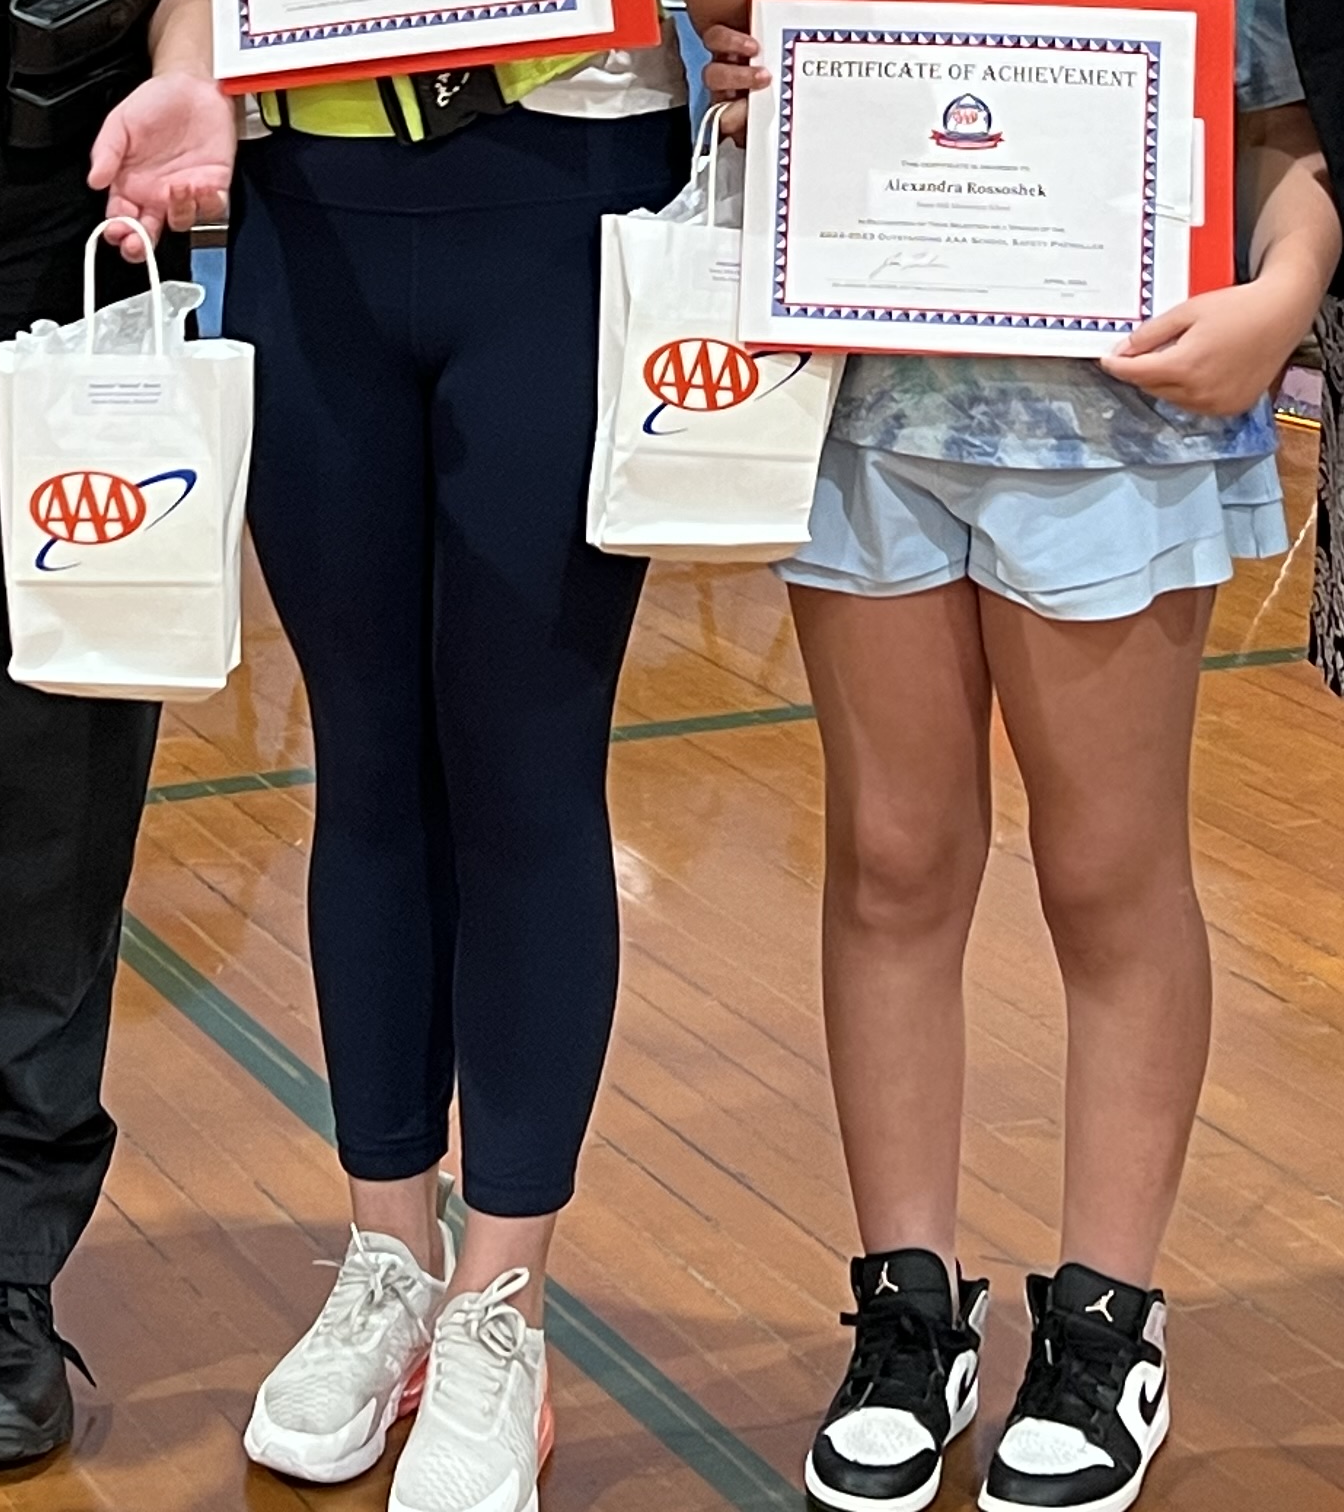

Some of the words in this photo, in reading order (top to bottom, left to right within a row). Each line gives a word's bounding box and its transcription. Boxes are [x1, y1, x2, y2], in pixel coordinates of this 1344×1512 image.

[802, 60, 942, 80] CERTIFICATE
[948, 63, 976, 81] OF
[982, 64, 1138, 88] ACHIEVEMENT
[884, 178, 963, 194] Alexandra
[966, 181, 1047, 197] Rossoshek
[653, 338, 750, 411] AAA
[37, 471, 139, 544] AAA
